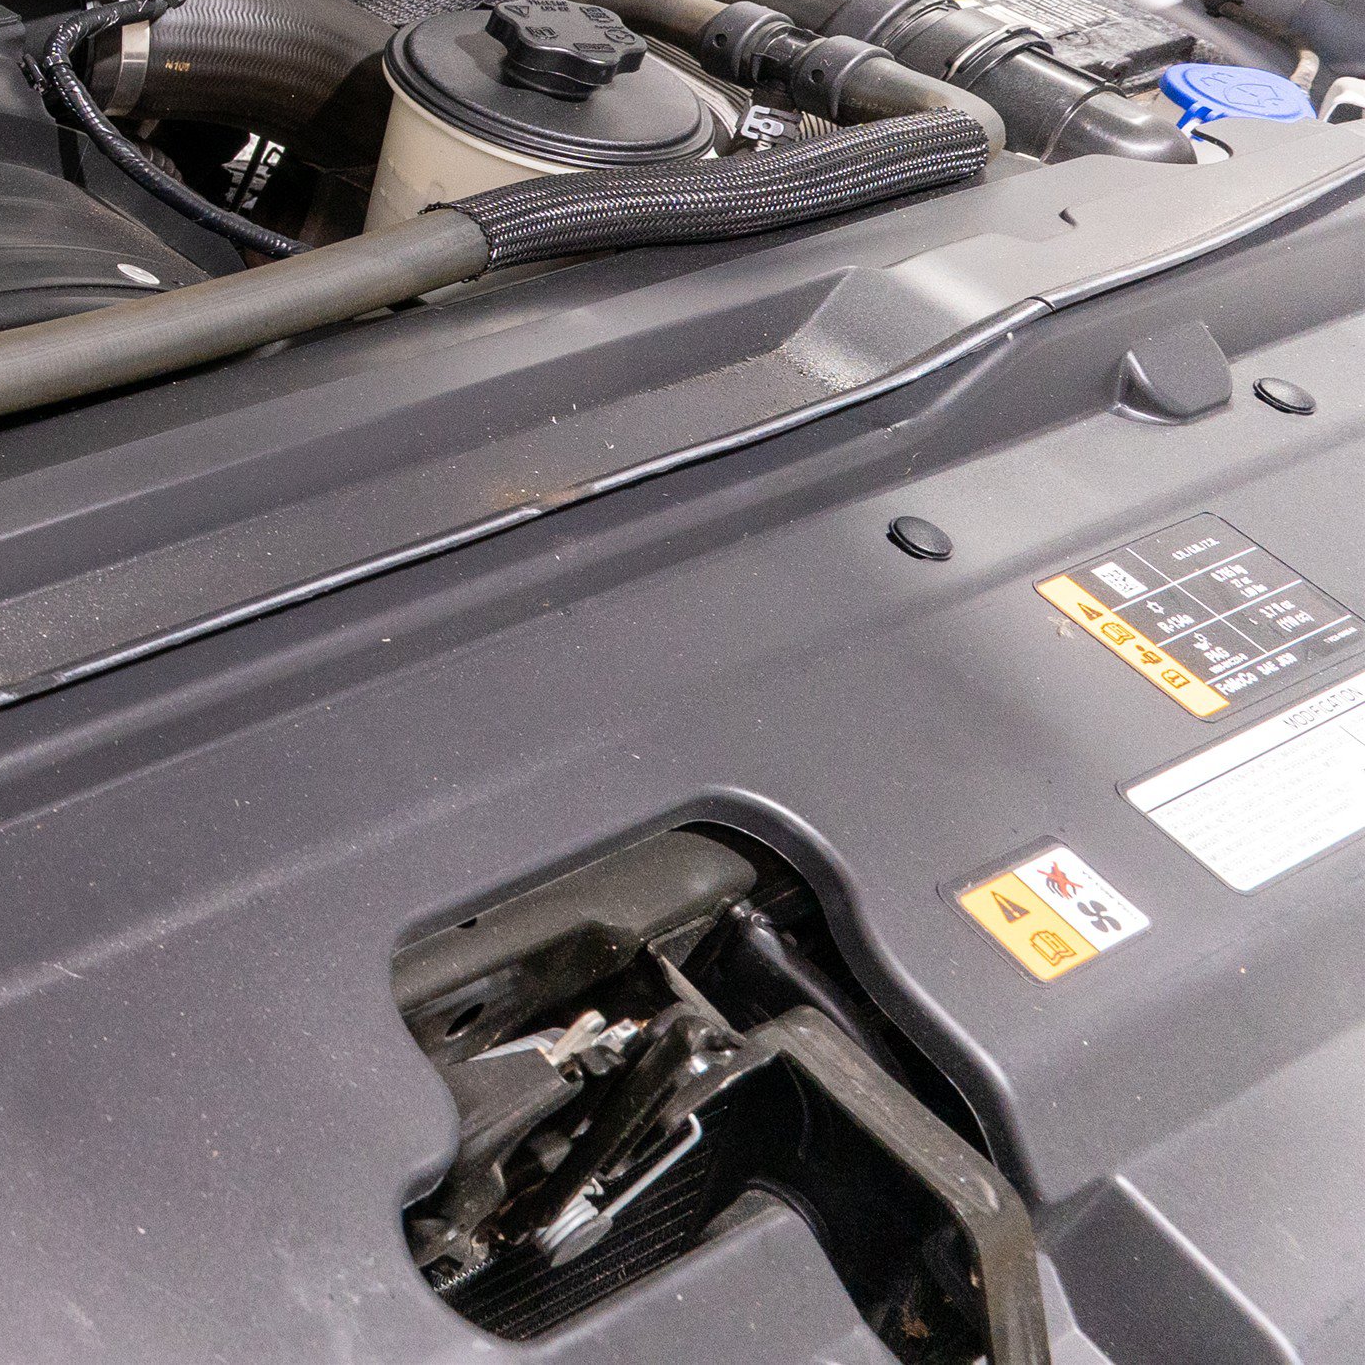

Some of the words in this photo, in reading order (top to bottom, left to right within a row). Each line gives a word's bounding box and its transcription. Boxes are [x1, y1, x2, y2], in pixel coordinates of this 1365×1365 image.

[1227, 562, 1250, 576] kg
[1278, 599, 1296, 610] oz
[1157, 614, 1195, 634] R-134a
[1290, 609, 1316, 625] cc)
[1203, 647, 1231, 663] PAG
[1215, 671, 1258, 697] FoMoCo
[1257, 659, 1279, 676] SAE
